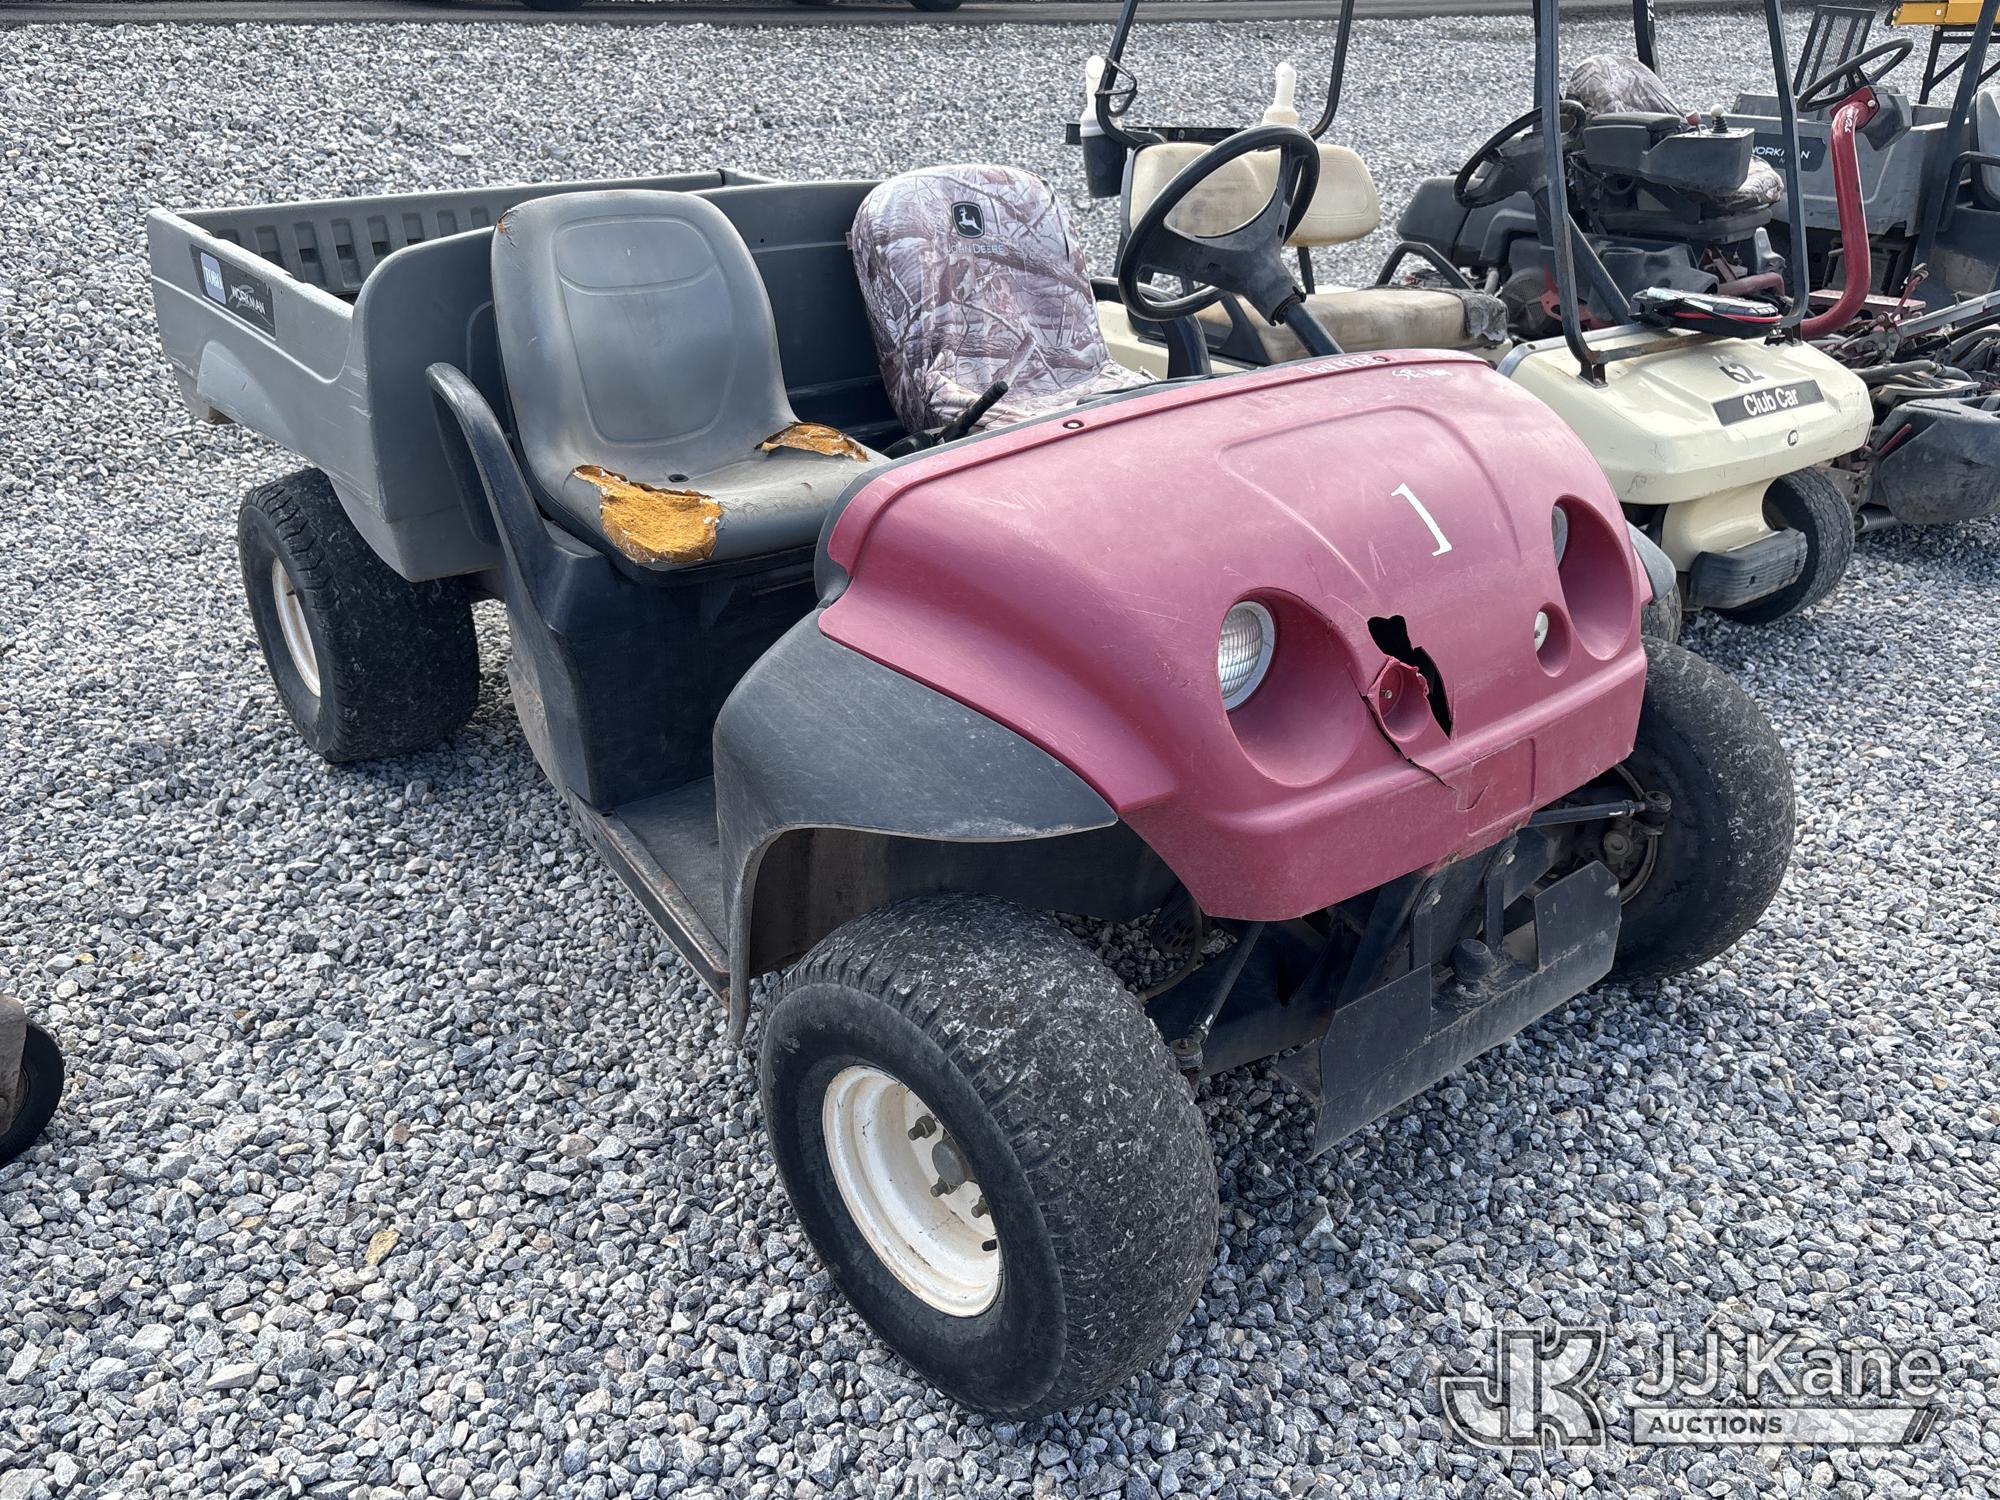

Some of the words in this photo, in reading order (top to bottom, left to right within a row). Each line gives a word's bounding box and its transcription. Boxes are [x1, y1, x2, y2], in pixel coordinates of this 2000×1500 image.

[1751, 146, 1811, 159] ORKN
[947, 244, 972, 254] JOHN
[974, 244, 1005, 254] DEERE
[230, 284, 266, 315] WORKMAN
[1719, 362, 1764, 384] 62
[1743, 392, 1777, 416] Club
[1775, 387, 1799, 408] Car
[1391, 482, 1453, 556] 1
